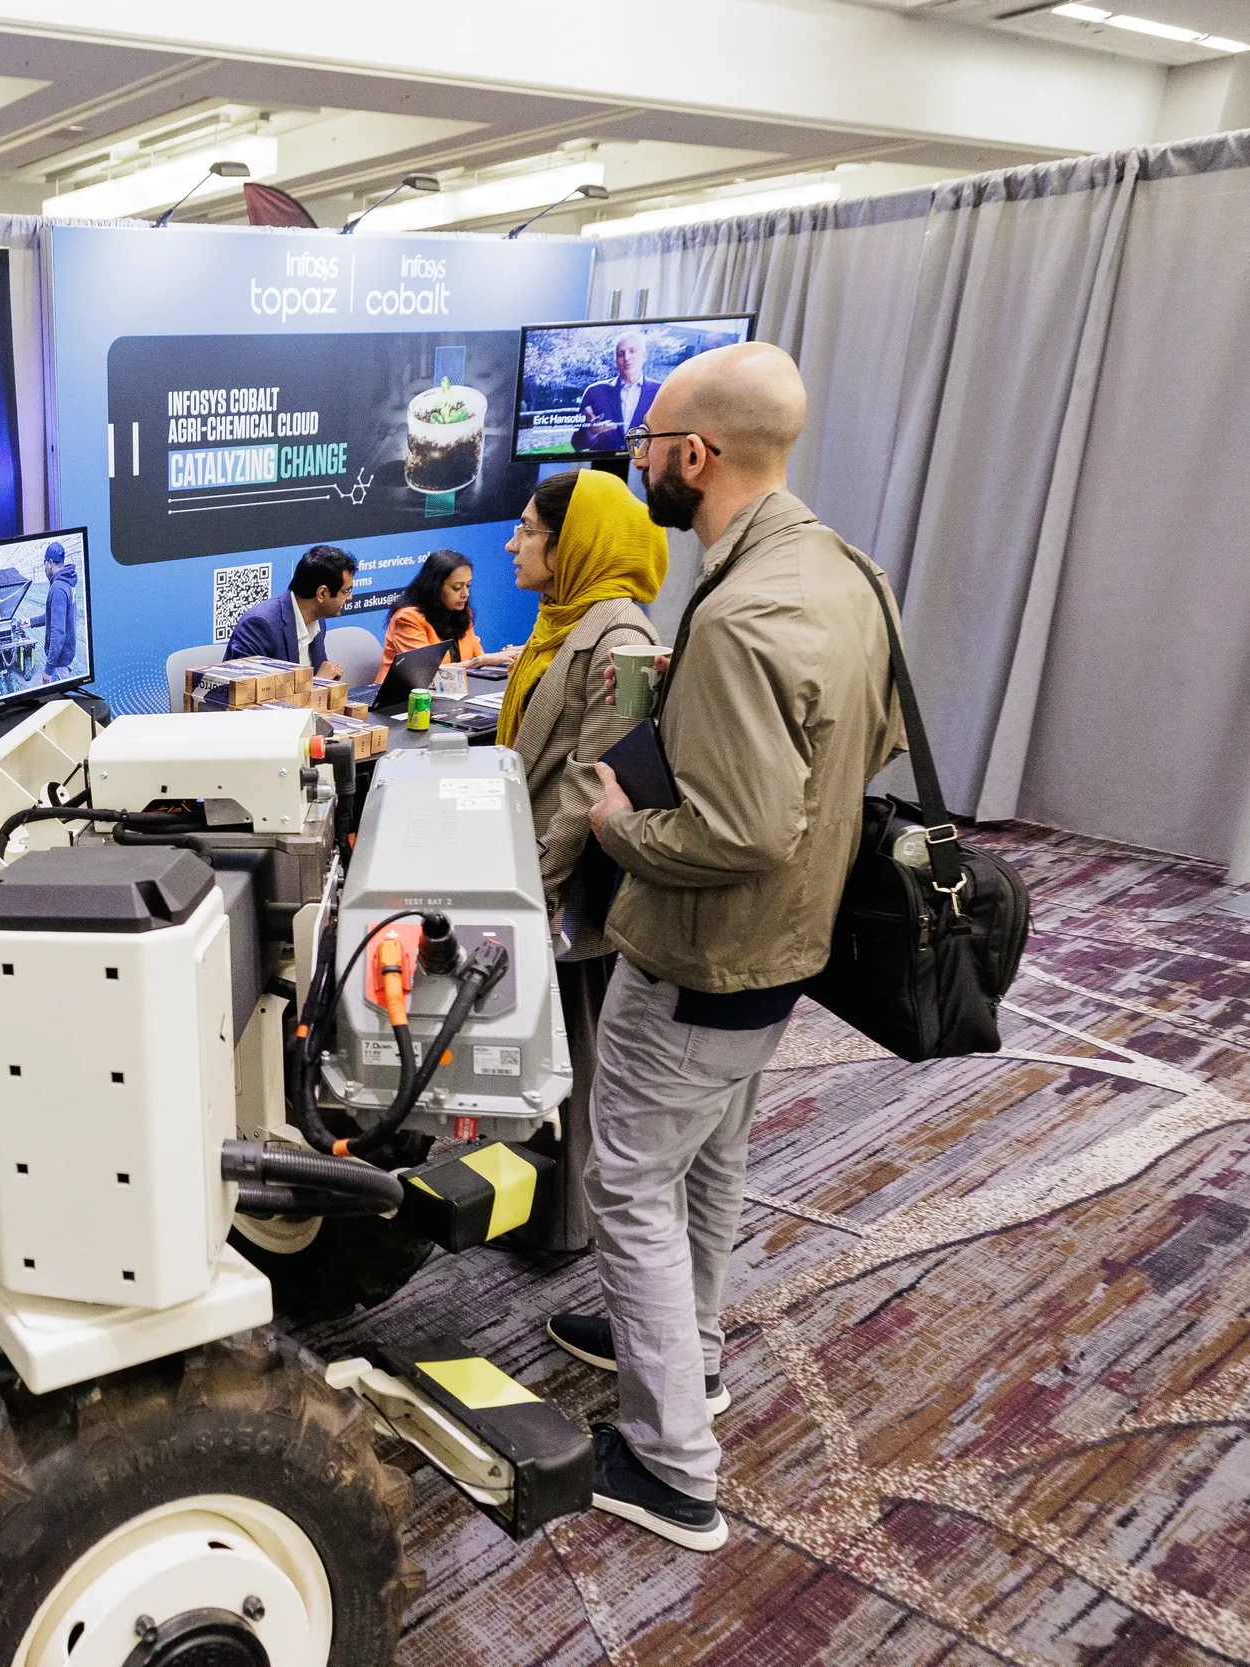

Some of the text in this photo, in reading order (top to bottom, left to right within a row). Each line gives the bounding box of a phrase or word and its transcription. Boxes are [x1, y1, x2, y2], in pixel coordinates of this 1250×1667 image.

[285, 250, 339, 282] Infosys
[400, 253, 446, 282] Infosys
[250, 277, 338, 323] topaz
[365, 282, 450, 315] cobalt
[168, 387, 280, 416] INFOSYS COBALT
[168, 411, 319, 443] AGRI-CHEMICAL CLOUD
[533, 414, 549, 425] Eric
[170, 442, 348, 488] CATALYZING CHANGE
[356, 551, 431, 571] -first services, sol
[344, 602, 353, 610] us
[354, 600, 361, 609] at
